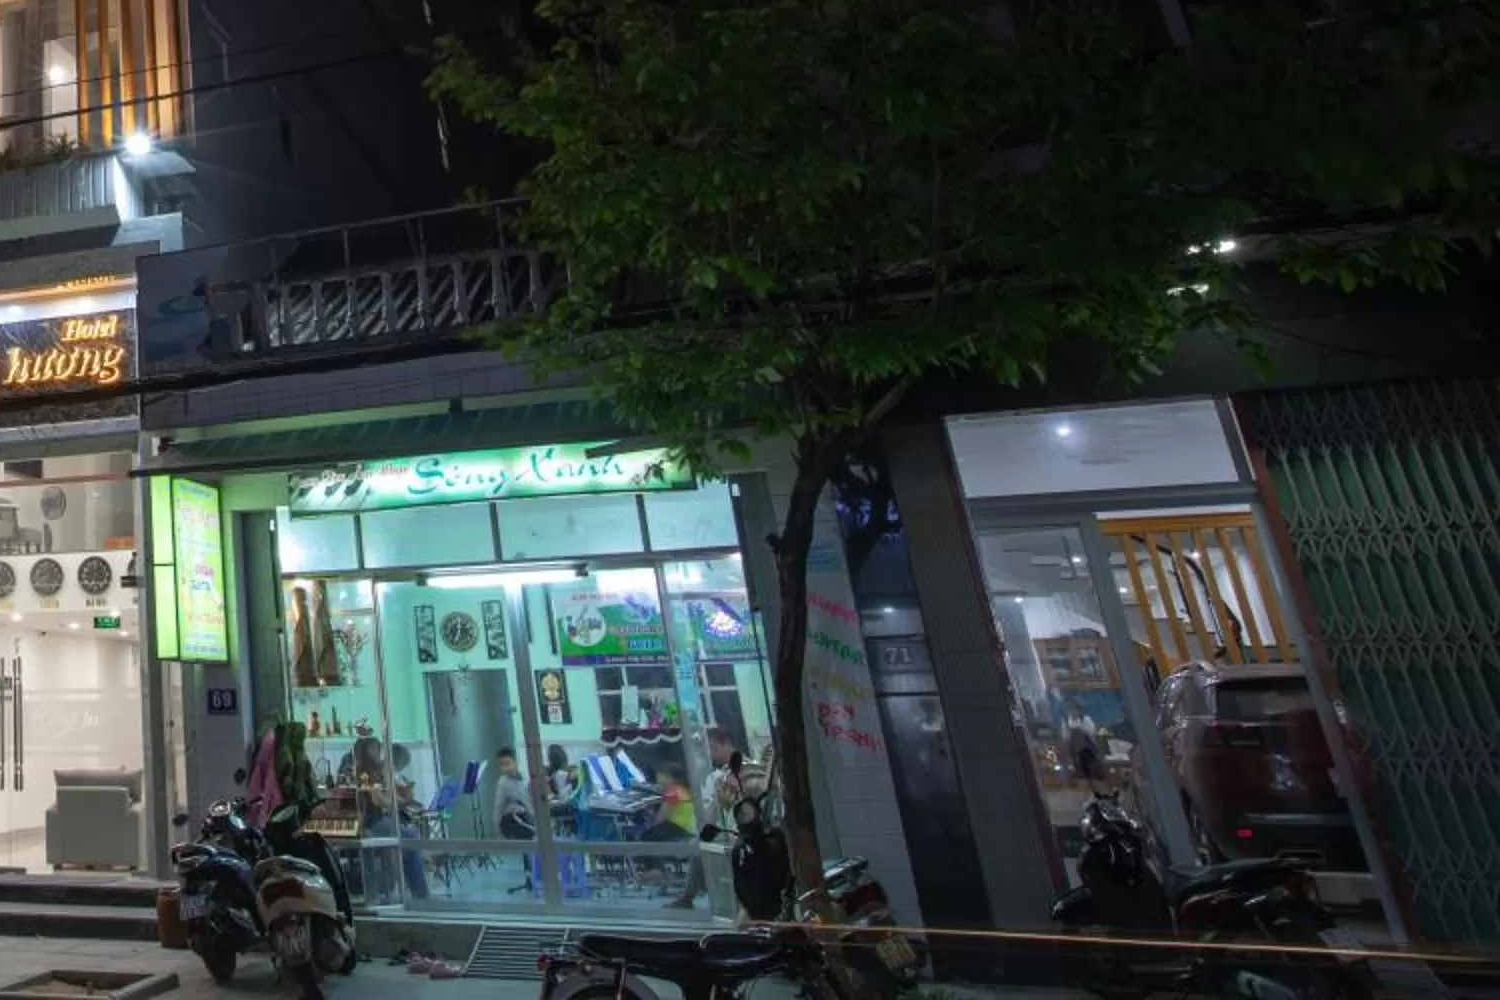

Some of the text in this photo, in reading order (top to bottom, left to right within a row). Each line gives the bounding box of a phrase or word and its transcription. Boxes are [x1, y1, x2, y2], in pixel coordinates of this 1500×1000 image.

[61, 314, 118, 341] Hotel
[514, 447, 624, 483] Xanh
[883, 646, 912, 664] 71
[211, 690, 232, 708] 69
